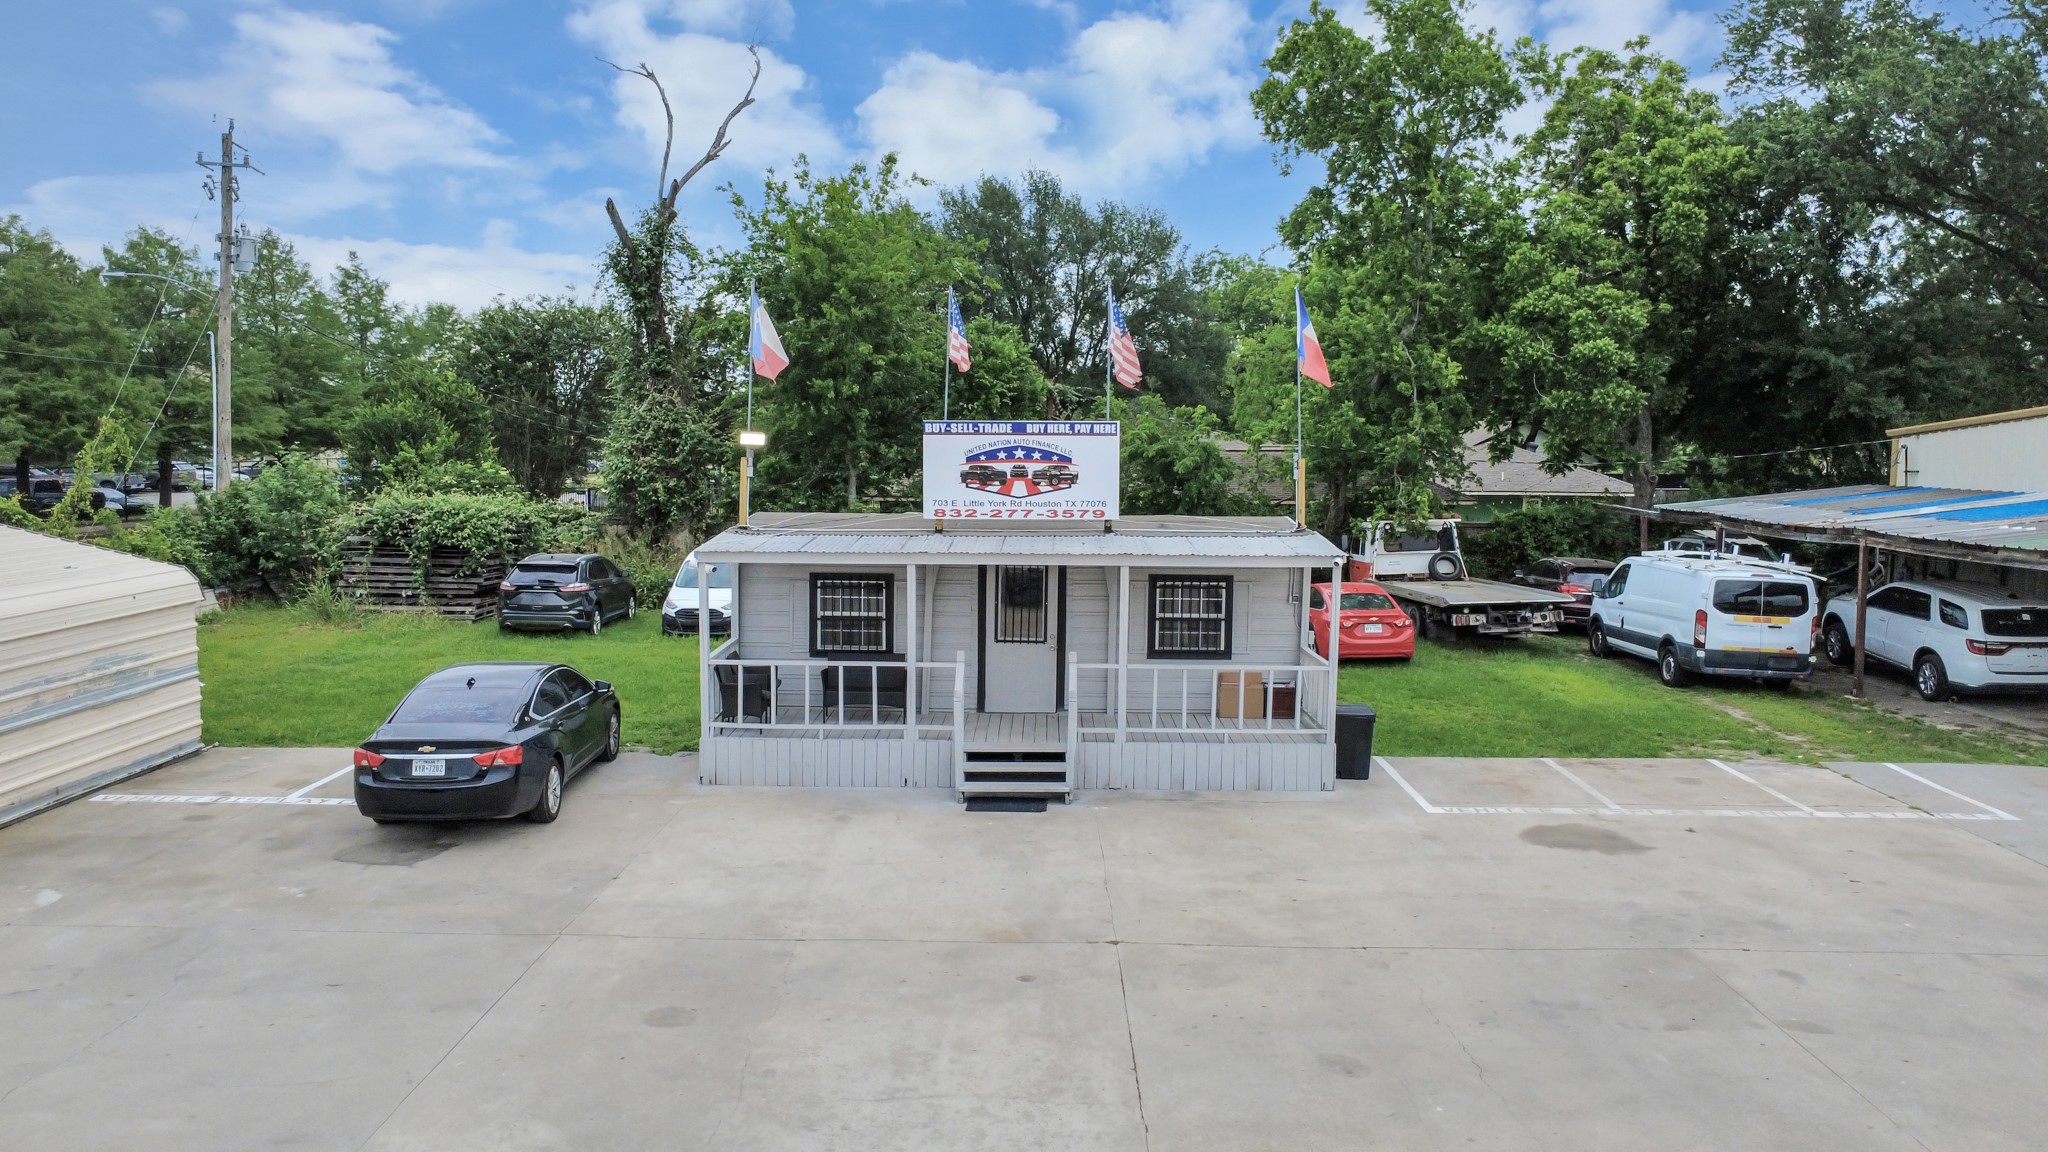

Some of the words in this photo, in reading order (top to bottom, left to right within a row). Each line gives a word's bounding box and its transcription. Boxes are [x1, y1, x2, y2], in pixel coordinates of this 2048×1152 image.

[924, 423, 1013, 433] BUY-SELL-TRADE
[1026, 423, 1045, 433] BUY
[1047, 424, 1073, 434] HERE,
[1074, 424, 1091, 434] PAY
[1093, 424, 1117, 434] HERE
[963, 443, 987, 456] UNITED
[988, 439, 1012, 449] NATION
[1013, 438, 1031, 446] AUTO
[1031, 440, 1059, 451] FINANCE
[932, 499, 949, 507] 703
[963, 499, 985, 507] Little
[1025, 500, 1062, 508] Houston
[1079, 500, 1107, 508] 77076
[933, 508, 1106, 518] 832-277-3579
